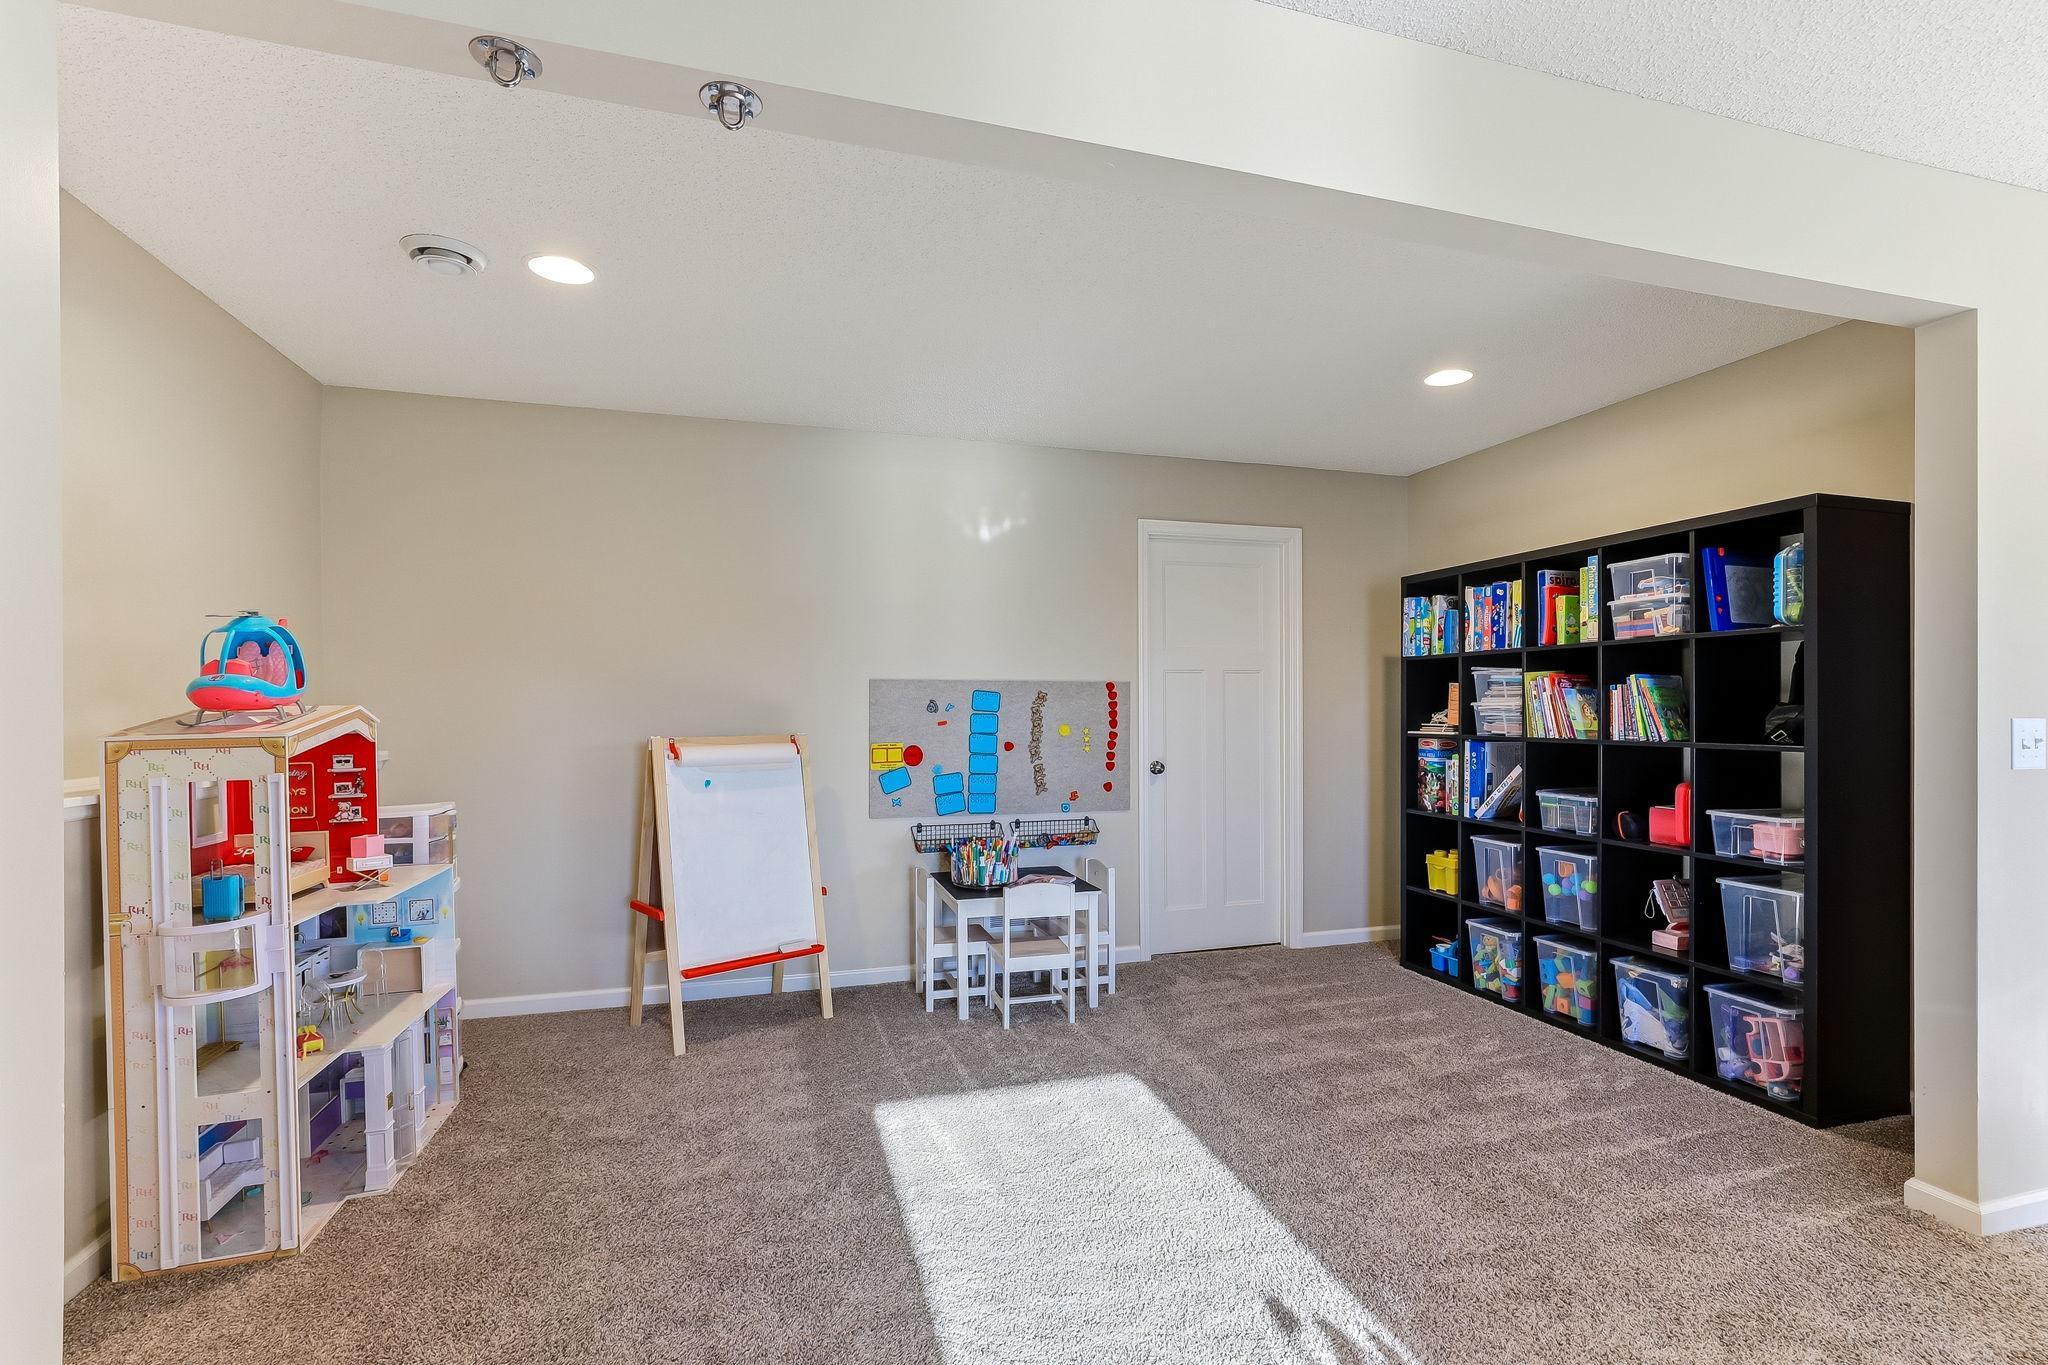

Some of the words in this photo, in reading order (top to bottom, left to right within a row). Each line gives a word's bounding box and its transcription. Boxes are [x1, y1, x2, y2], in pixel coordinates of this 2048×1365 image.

[148, 762, 165, 772] RH
[193, 761, 210, 771] RH
[125, 779, 143, 789] RH
[126, 810, 143, 820] RH
[128, 905, 145, 915] RH
[174, 902, 190, 911] RH
[132, 1031, 149, 1041] RH
[177, 1026, 194, 1036] RH
[135, 1188, 152, 1197] RH
[182, 1212, 198, 1222] RH
[136, 1219, 153, 1229] RH
[136, 1250, 153, 1260] RH
